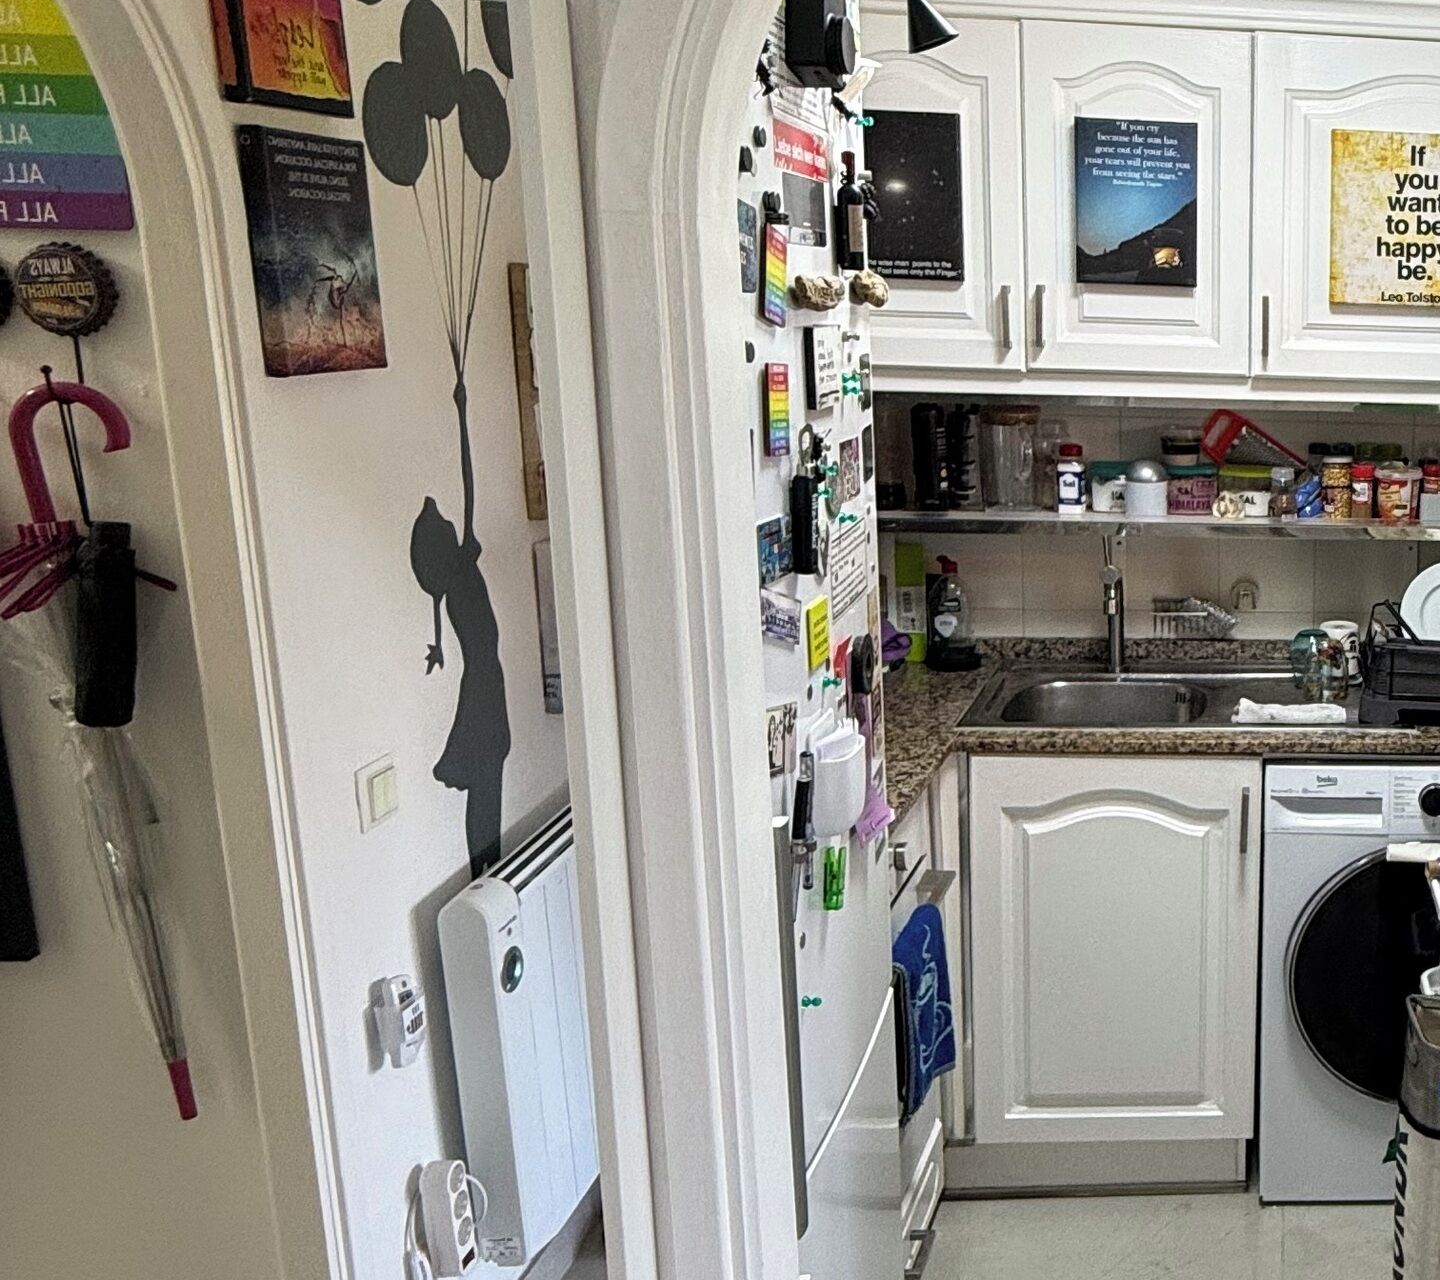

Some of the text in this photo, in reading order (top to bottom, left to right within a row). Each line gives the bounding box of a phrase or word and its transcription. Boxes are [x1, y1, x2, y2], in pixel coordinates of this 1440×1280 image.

[1411, 146, 1426, 166] If
[1395, 174, 1438, 194] you
[1386, 215, 1409, 235] to
[1397, 260, 1432, 280] be.
[1381, 292, 1403, 302] Leo
[1062, 479, 1076, 488] Sal
